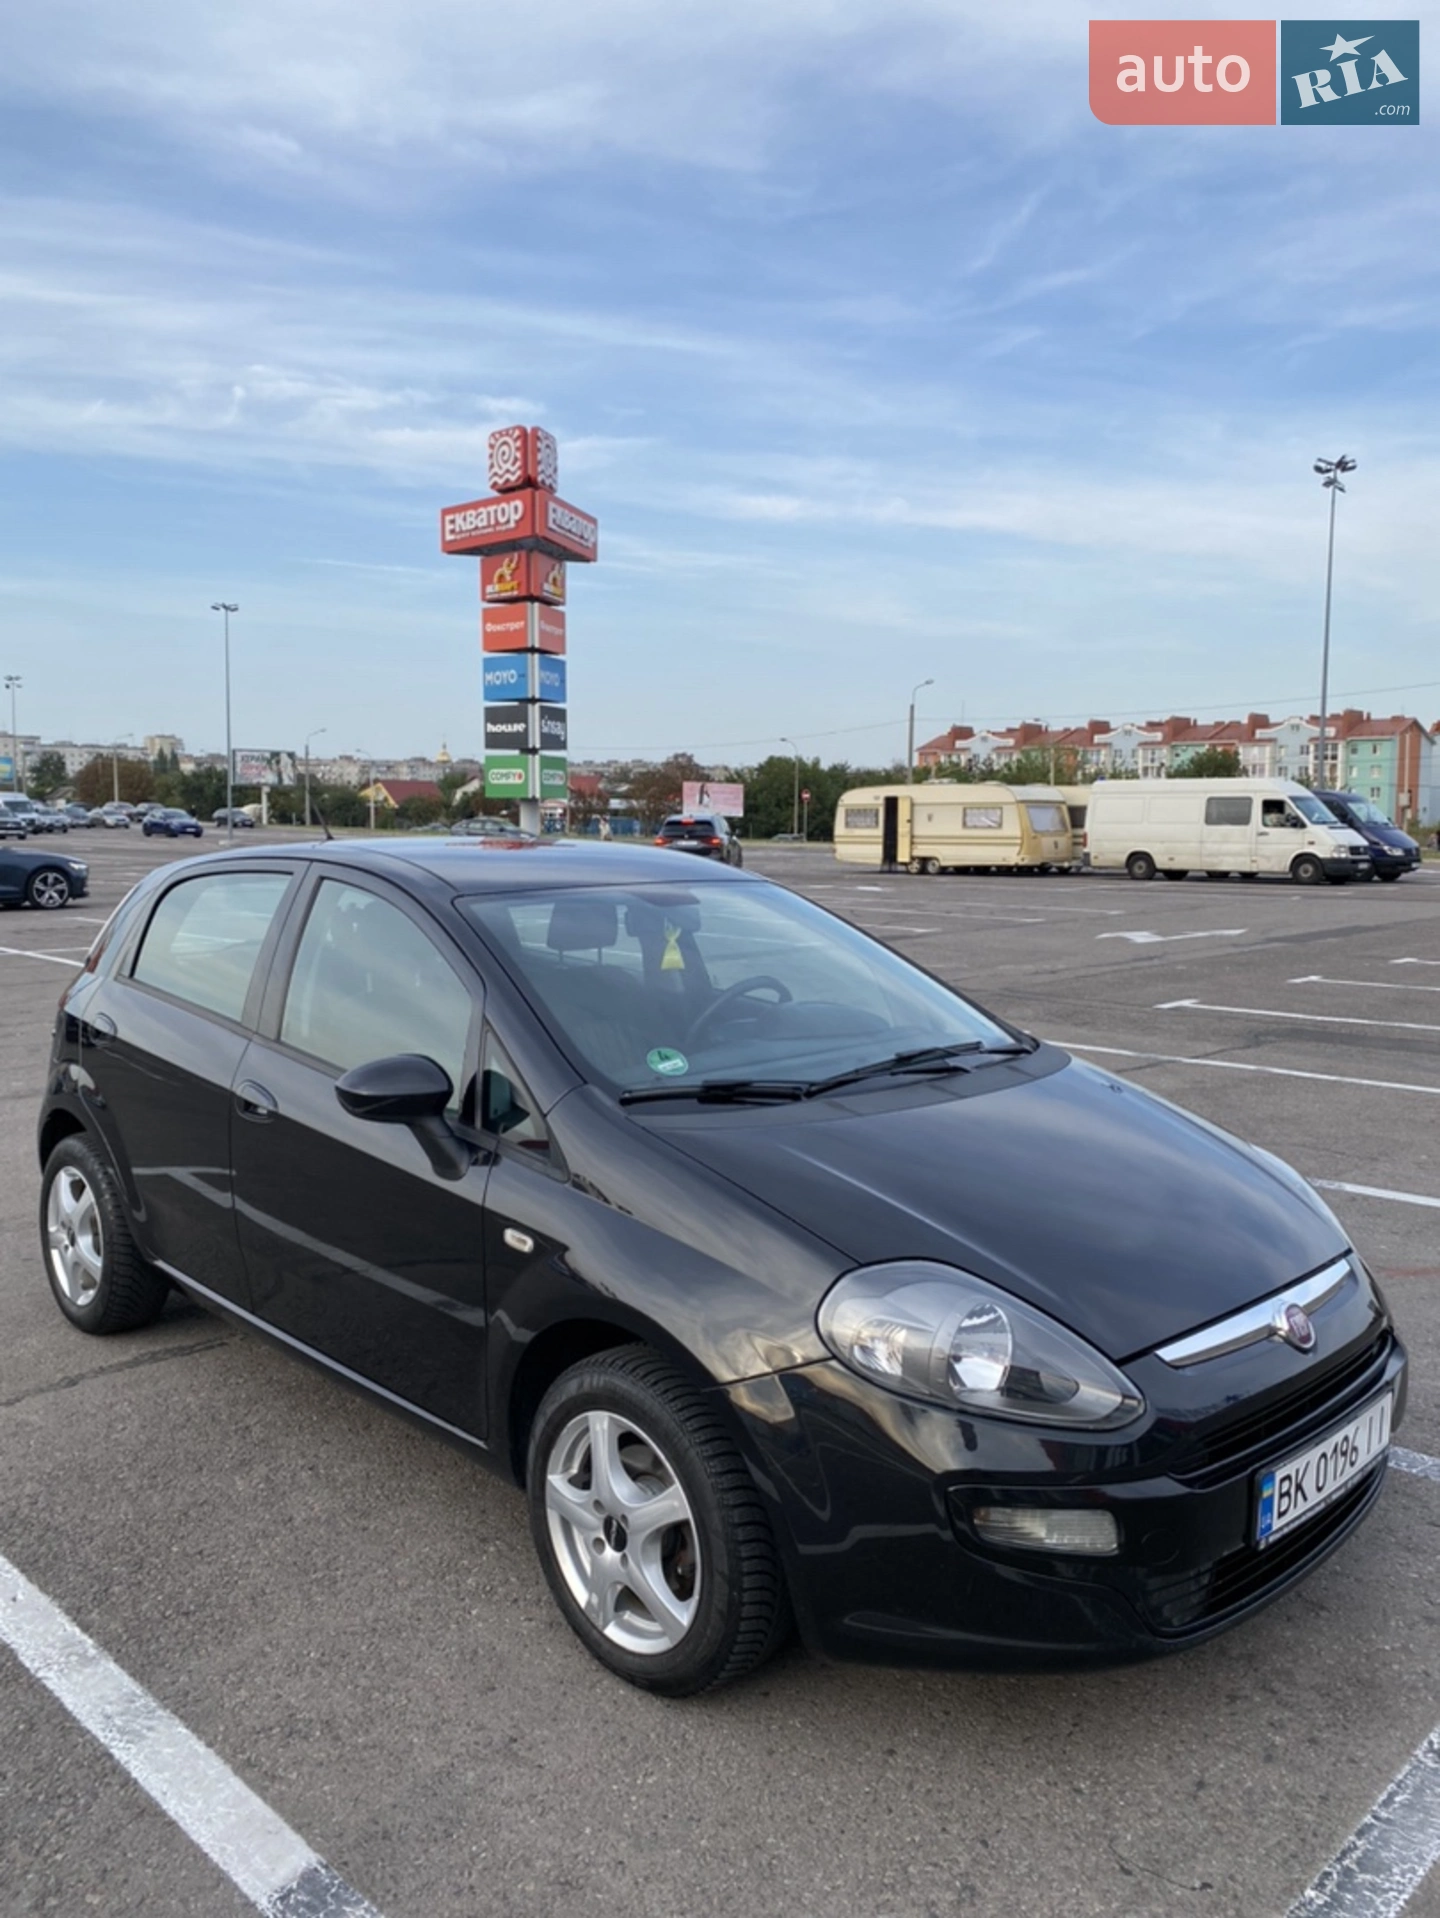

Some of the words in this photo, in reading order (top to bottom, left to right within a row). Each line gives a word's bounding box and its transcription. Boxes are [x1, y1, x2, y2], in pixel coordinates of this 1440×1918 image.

[486, 721, 527, 733] house
[490, 771, 517, 782] COMFY
[1277, 1460, 1312, 1520] BK
[1315, 1427, 1359, 1493] 0196
